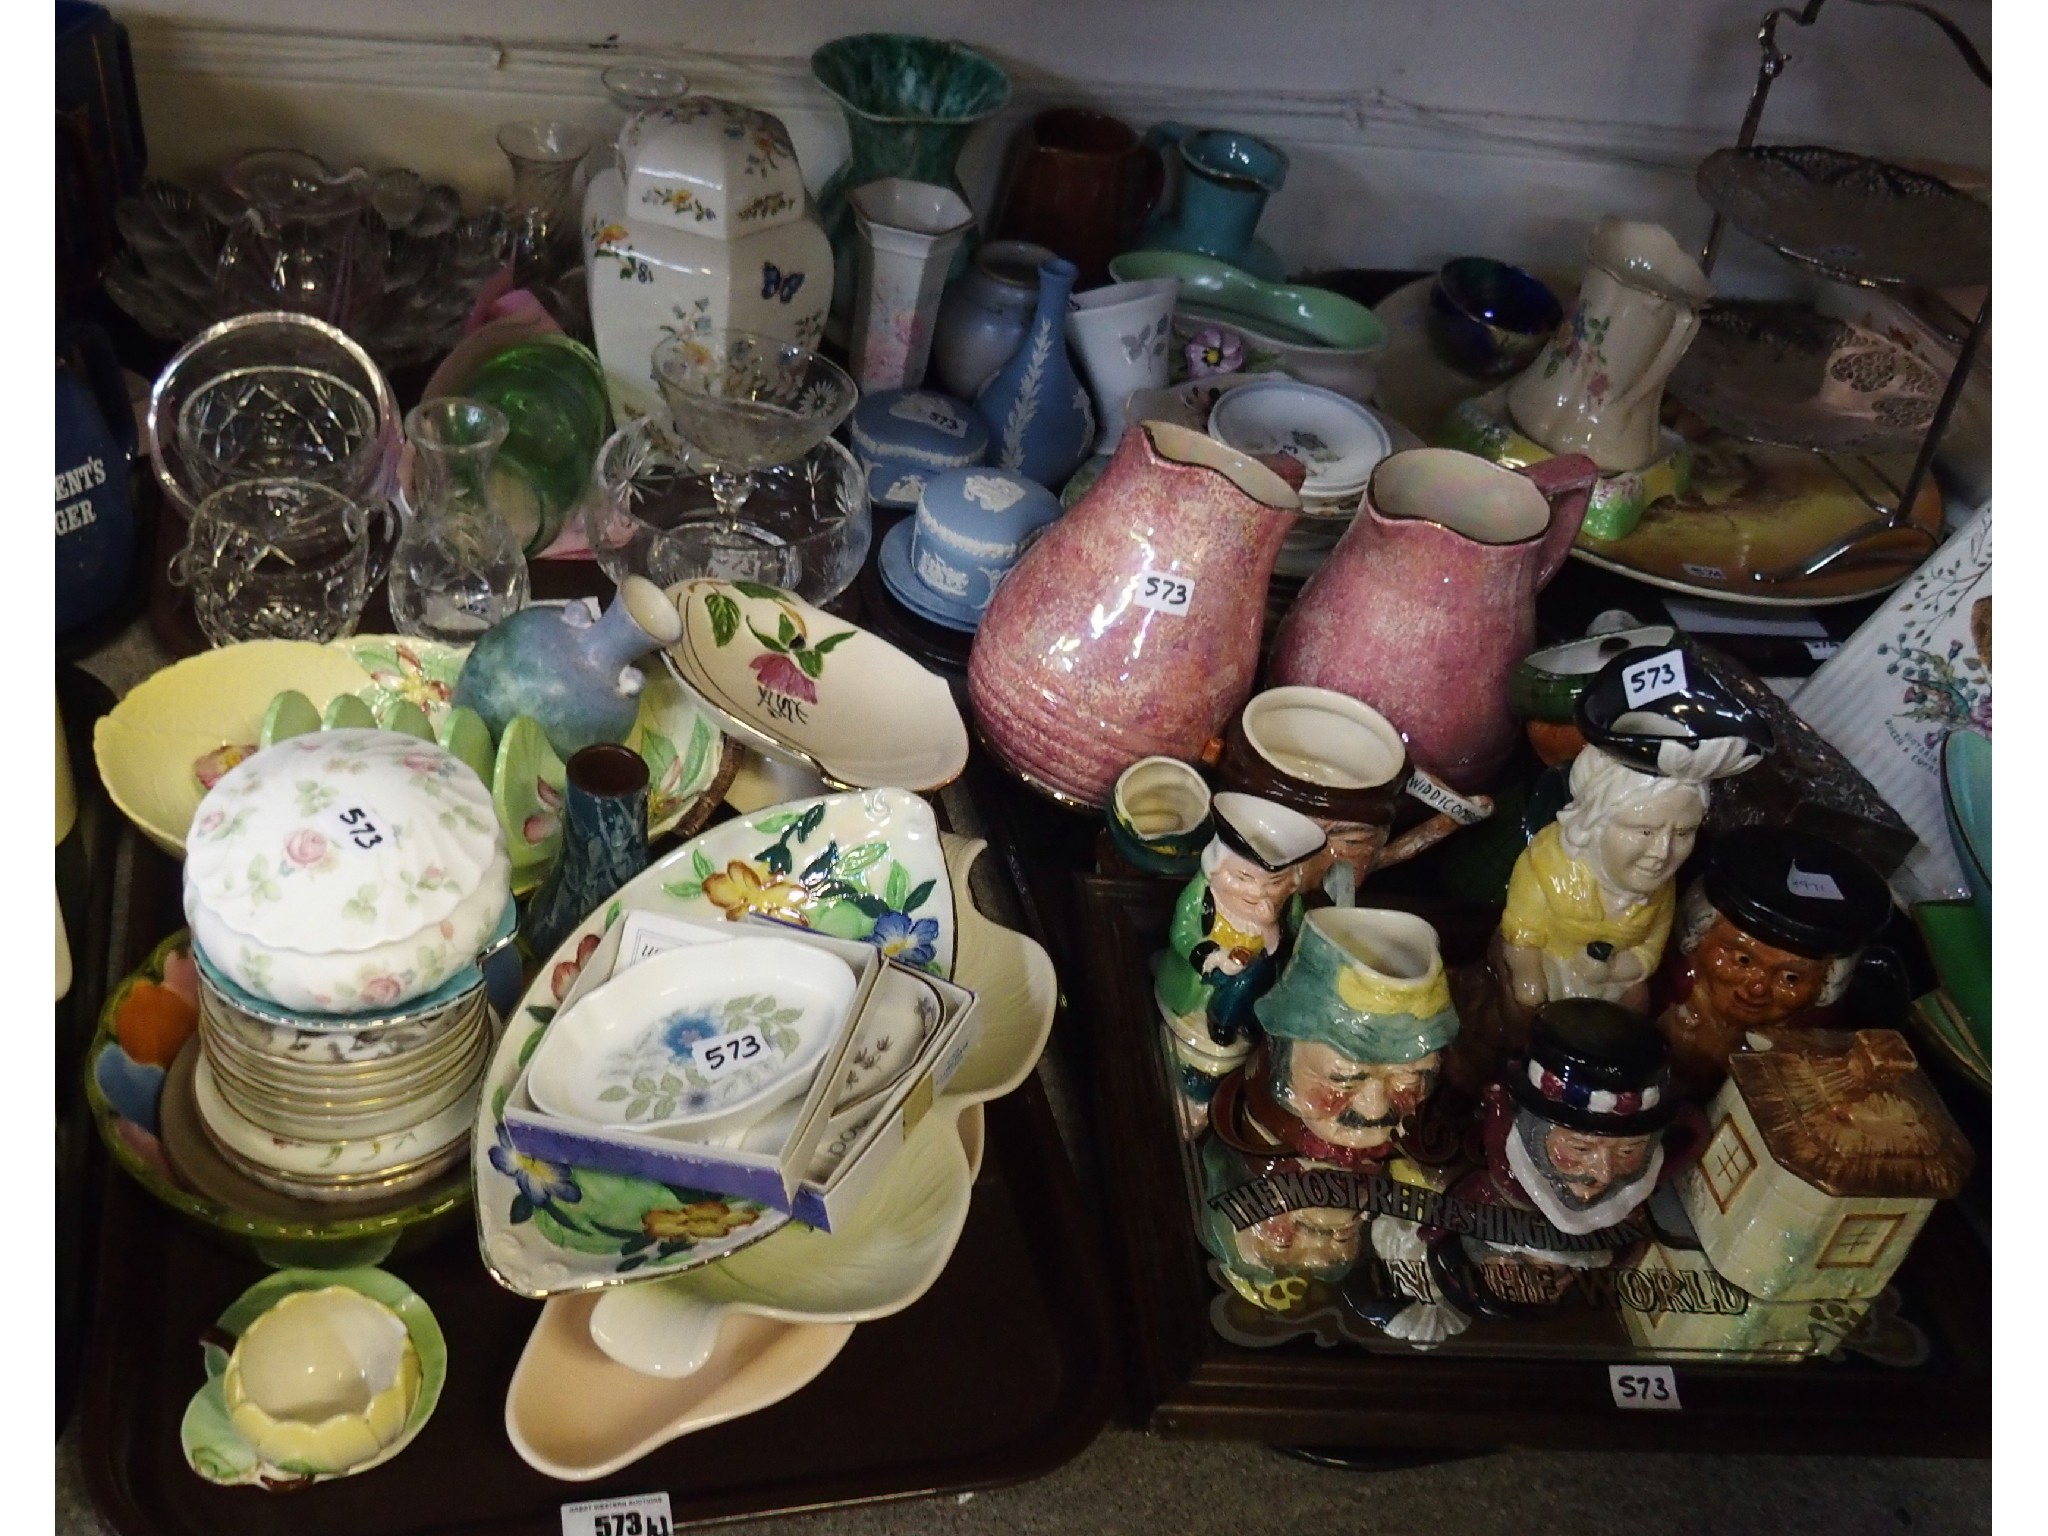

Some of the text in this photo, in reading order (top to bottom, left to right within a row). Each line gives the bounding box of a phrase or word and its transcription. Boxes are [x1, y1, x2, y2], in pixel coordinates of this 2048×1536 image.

[1145, 576, 1187, 605] 573
[1631, 663, 1676, 694] 573
[339, 808, 383, 849] 573
[705, 1035, 760, 1070] 573
[1210, 1175, 1282, 1232] THE
[1272, 1169, 1361, 1212] MOST
[1366, 1174, 1547, 1250] REFRESHING
[1575, 1264, 1751, 1316] WORLD
[1618, 1375, 1670, 1400] 573
[594, 1512, 643, 1536] 573
